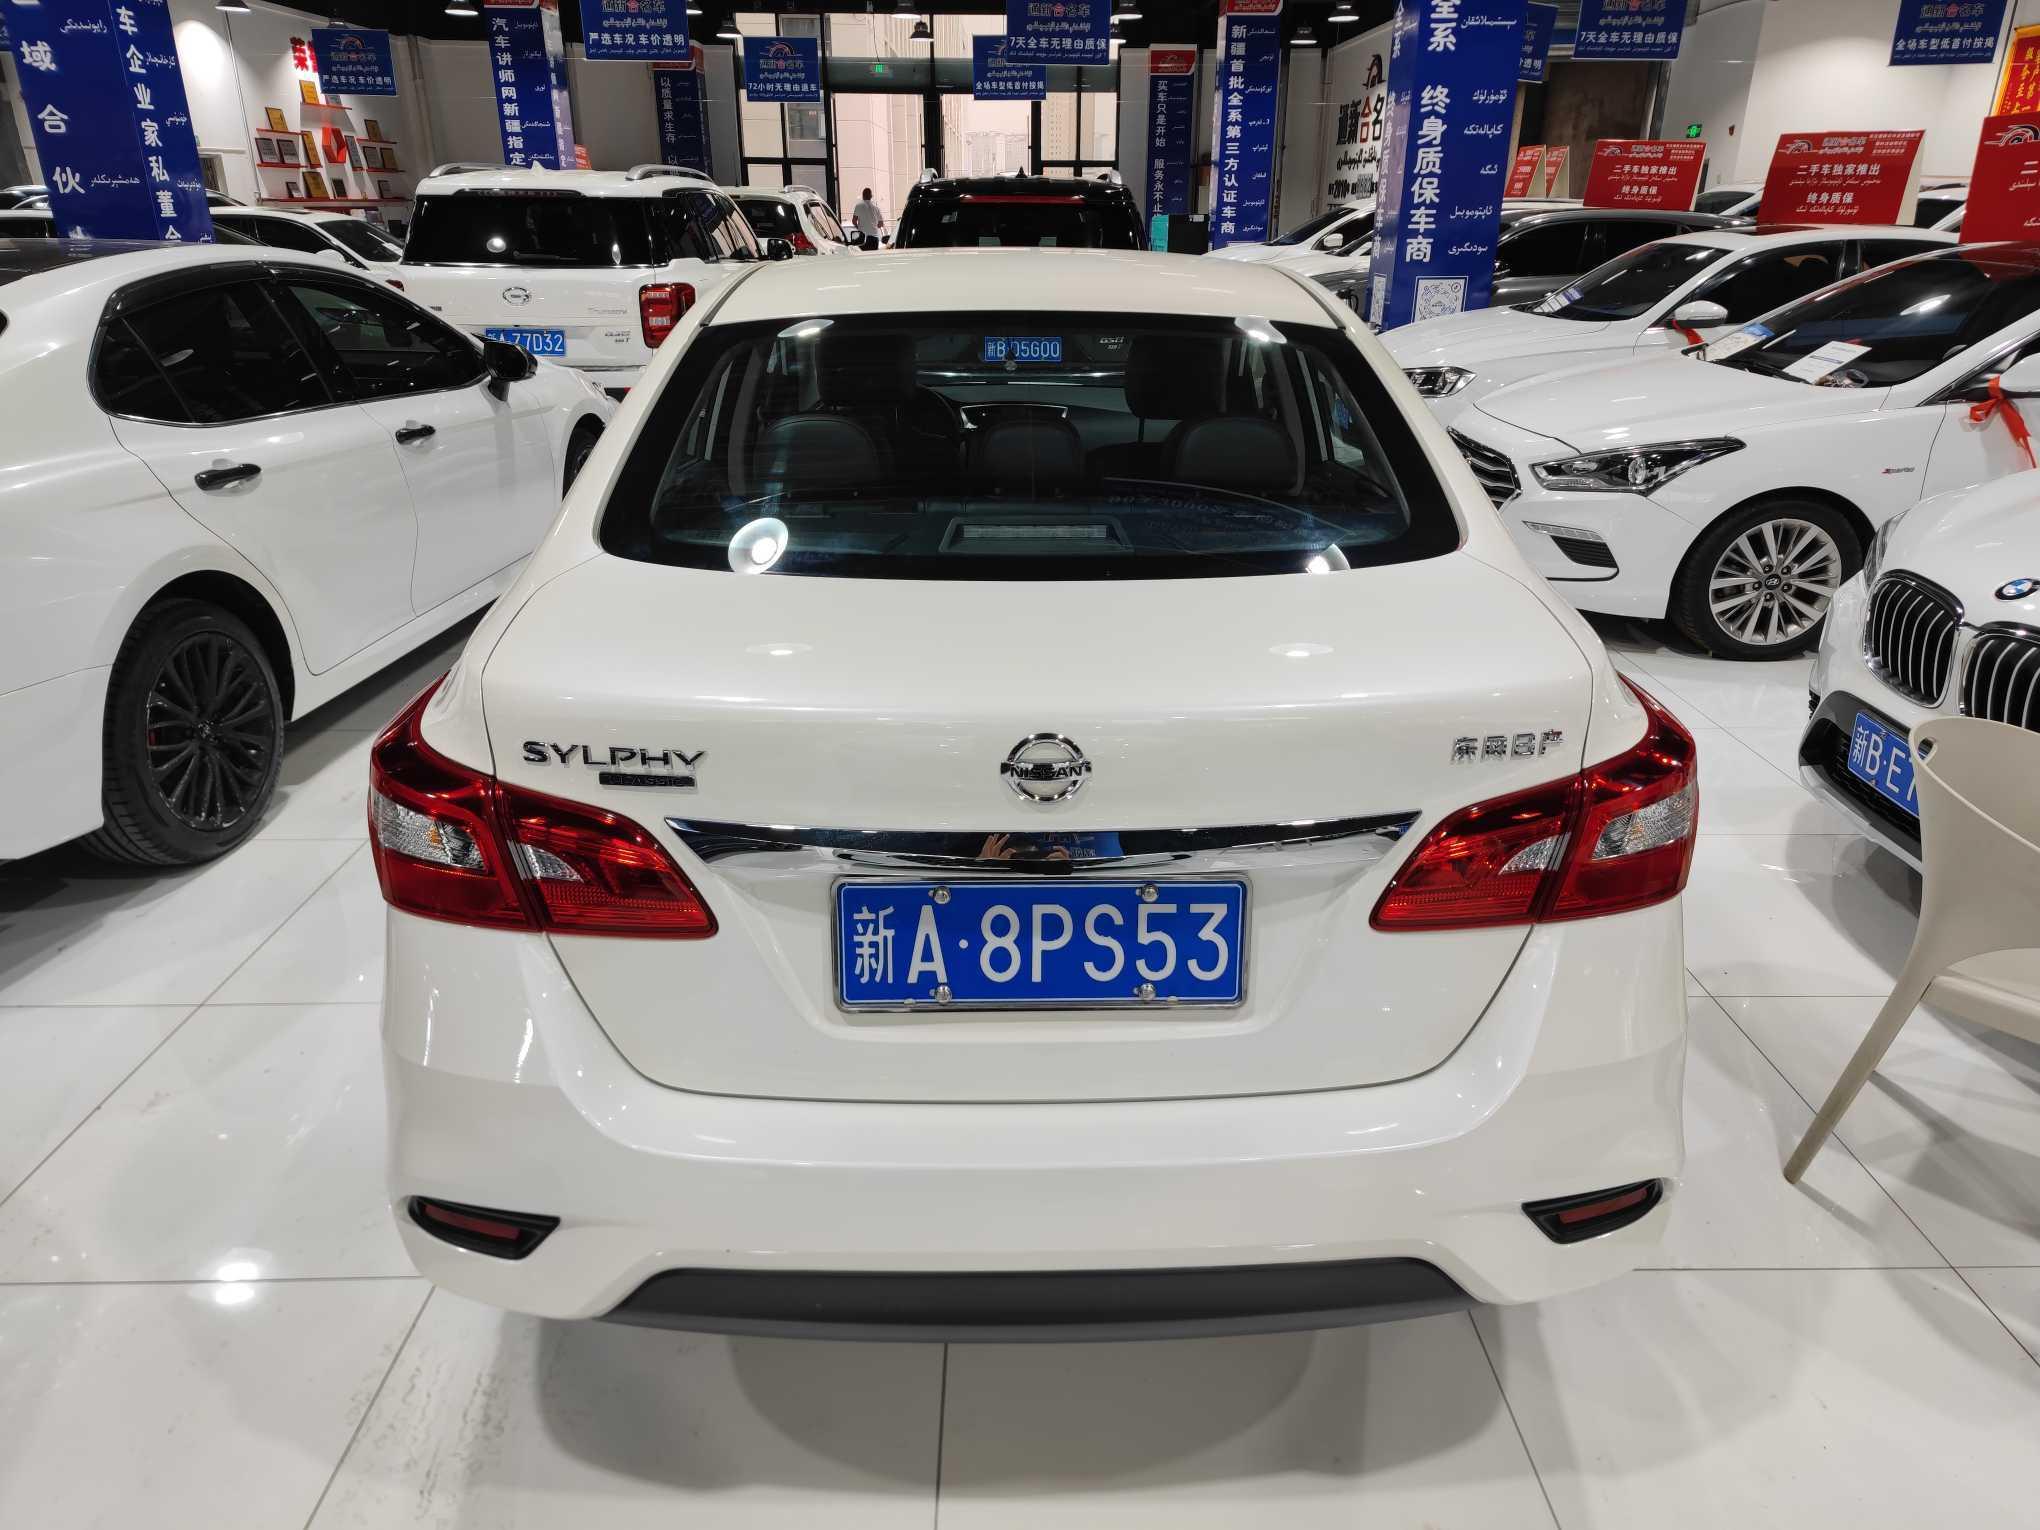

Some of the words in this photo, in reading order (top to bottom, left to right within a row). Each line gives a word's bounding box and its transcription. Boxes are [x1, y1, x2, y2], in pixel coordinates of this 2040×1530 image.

[1009, 36, 1108, 50] 7天全车无理由质保
[1579, 31, 1679, 44] 7天全车无理由质保
[491, 16, 527, 166] 汽车讲师网新疆指定
[1154, 80, 1169, 148] 买车只是开始
[1220, 24, 1248, 235] 新疆首批全系第三方认证车商
[1404, 84, 1451, 263] 终身质保车商
[1797, 163, 1881, 176] 二手车独家推出
[1805, 192, 1855, 204] 终身质保
[522, 740, 708, 767] SYLPHY
[1009, 764, 1083, 779] NISSAN
[852, 903, 1230, 985] 新A·8PS53
